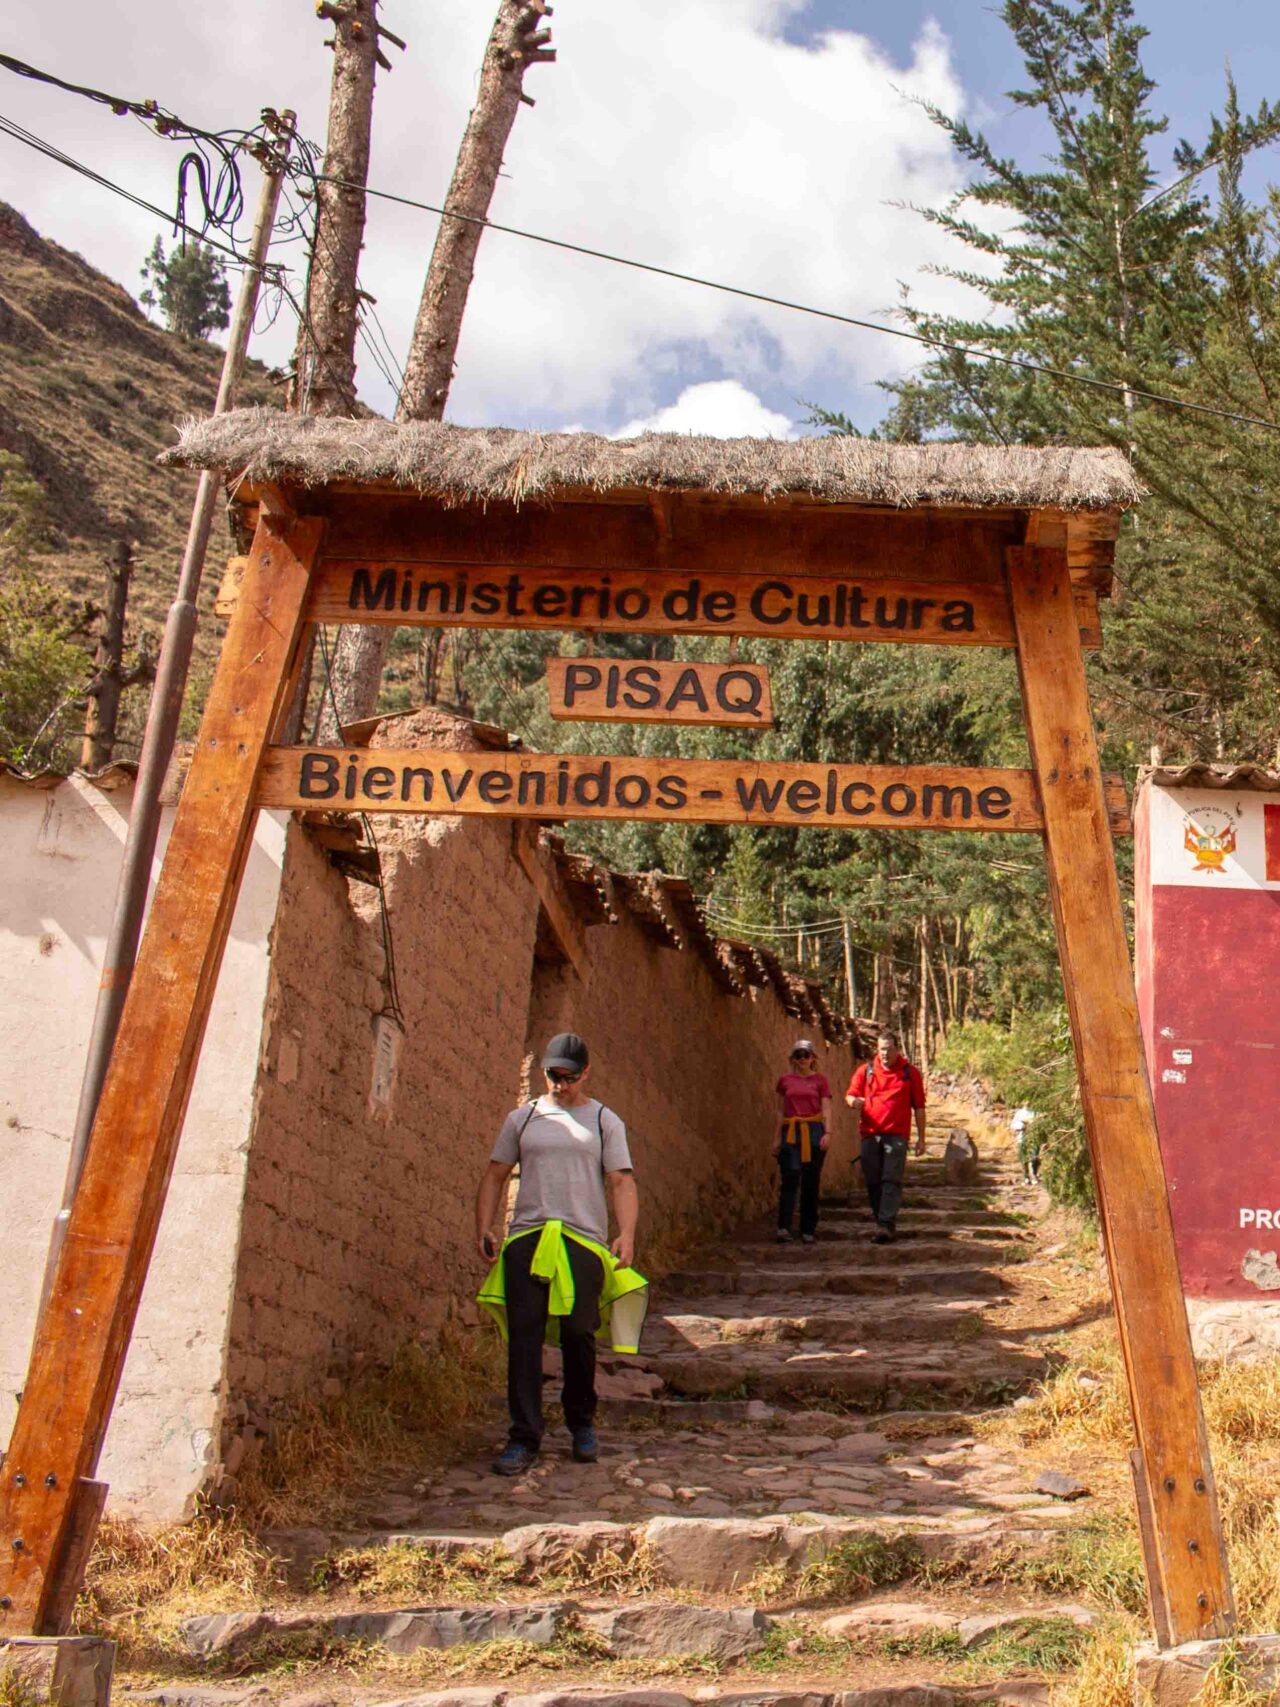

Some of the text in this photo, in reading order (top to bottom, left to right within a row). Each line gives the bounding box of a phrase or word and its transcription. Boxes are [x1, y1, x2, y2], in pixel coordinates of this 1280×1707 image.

[348, 567, 975, 632] Ministerio de Cultura
[563, 664, 763, 718] PISAQ
[300, 752, 1012, 820] Bienvenidos - welcome
